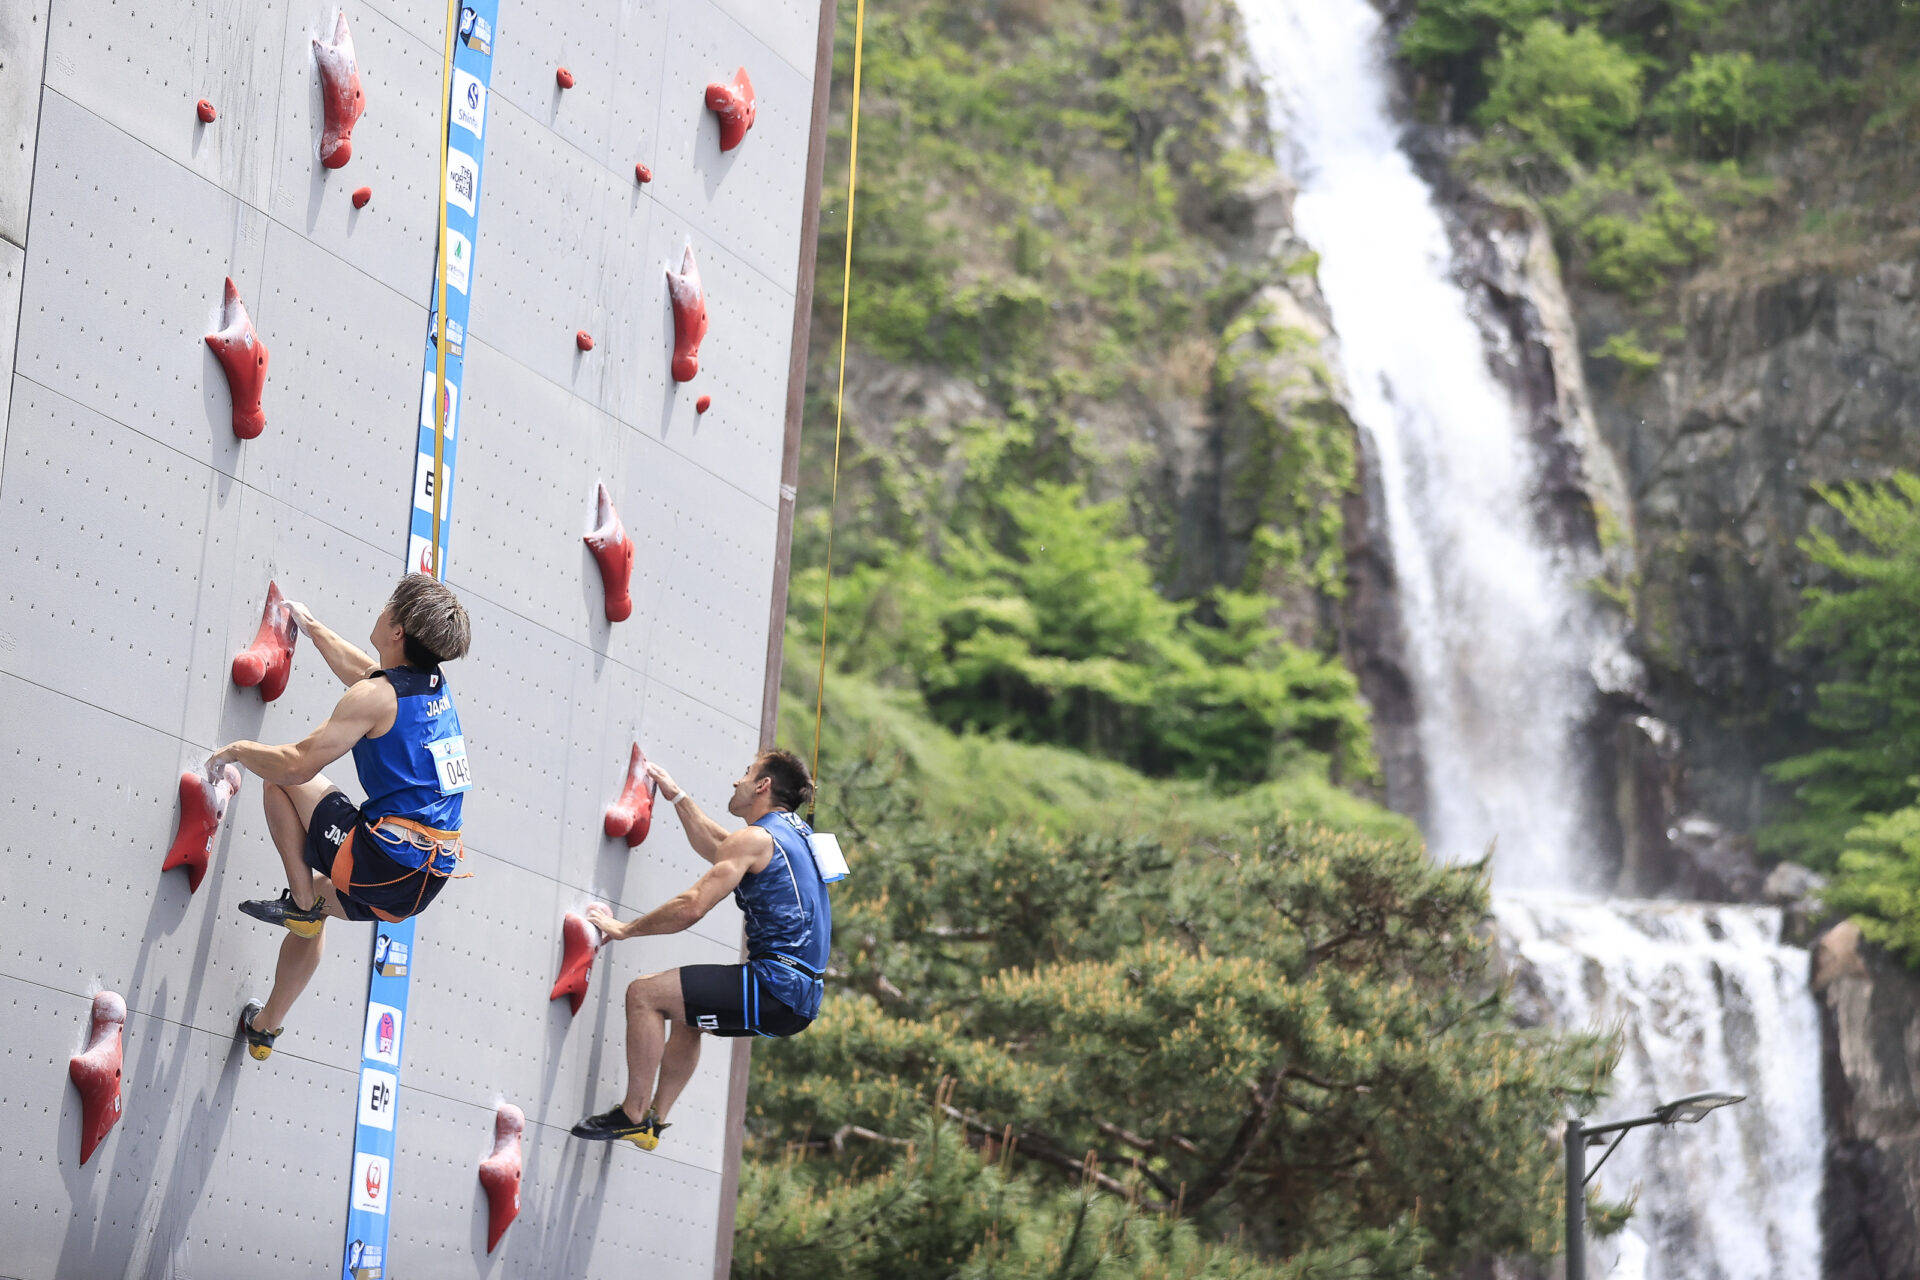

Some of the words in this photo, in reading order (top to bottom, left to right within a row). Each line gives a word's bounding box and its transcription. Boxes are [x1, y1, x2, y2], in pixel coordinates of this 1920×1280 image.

[450, 170, 469, 187] NORTH
[461, 165, 470, 179] THE
[455, 182, 469, 198] FACE
[324, 824, 348, 846] JAP
